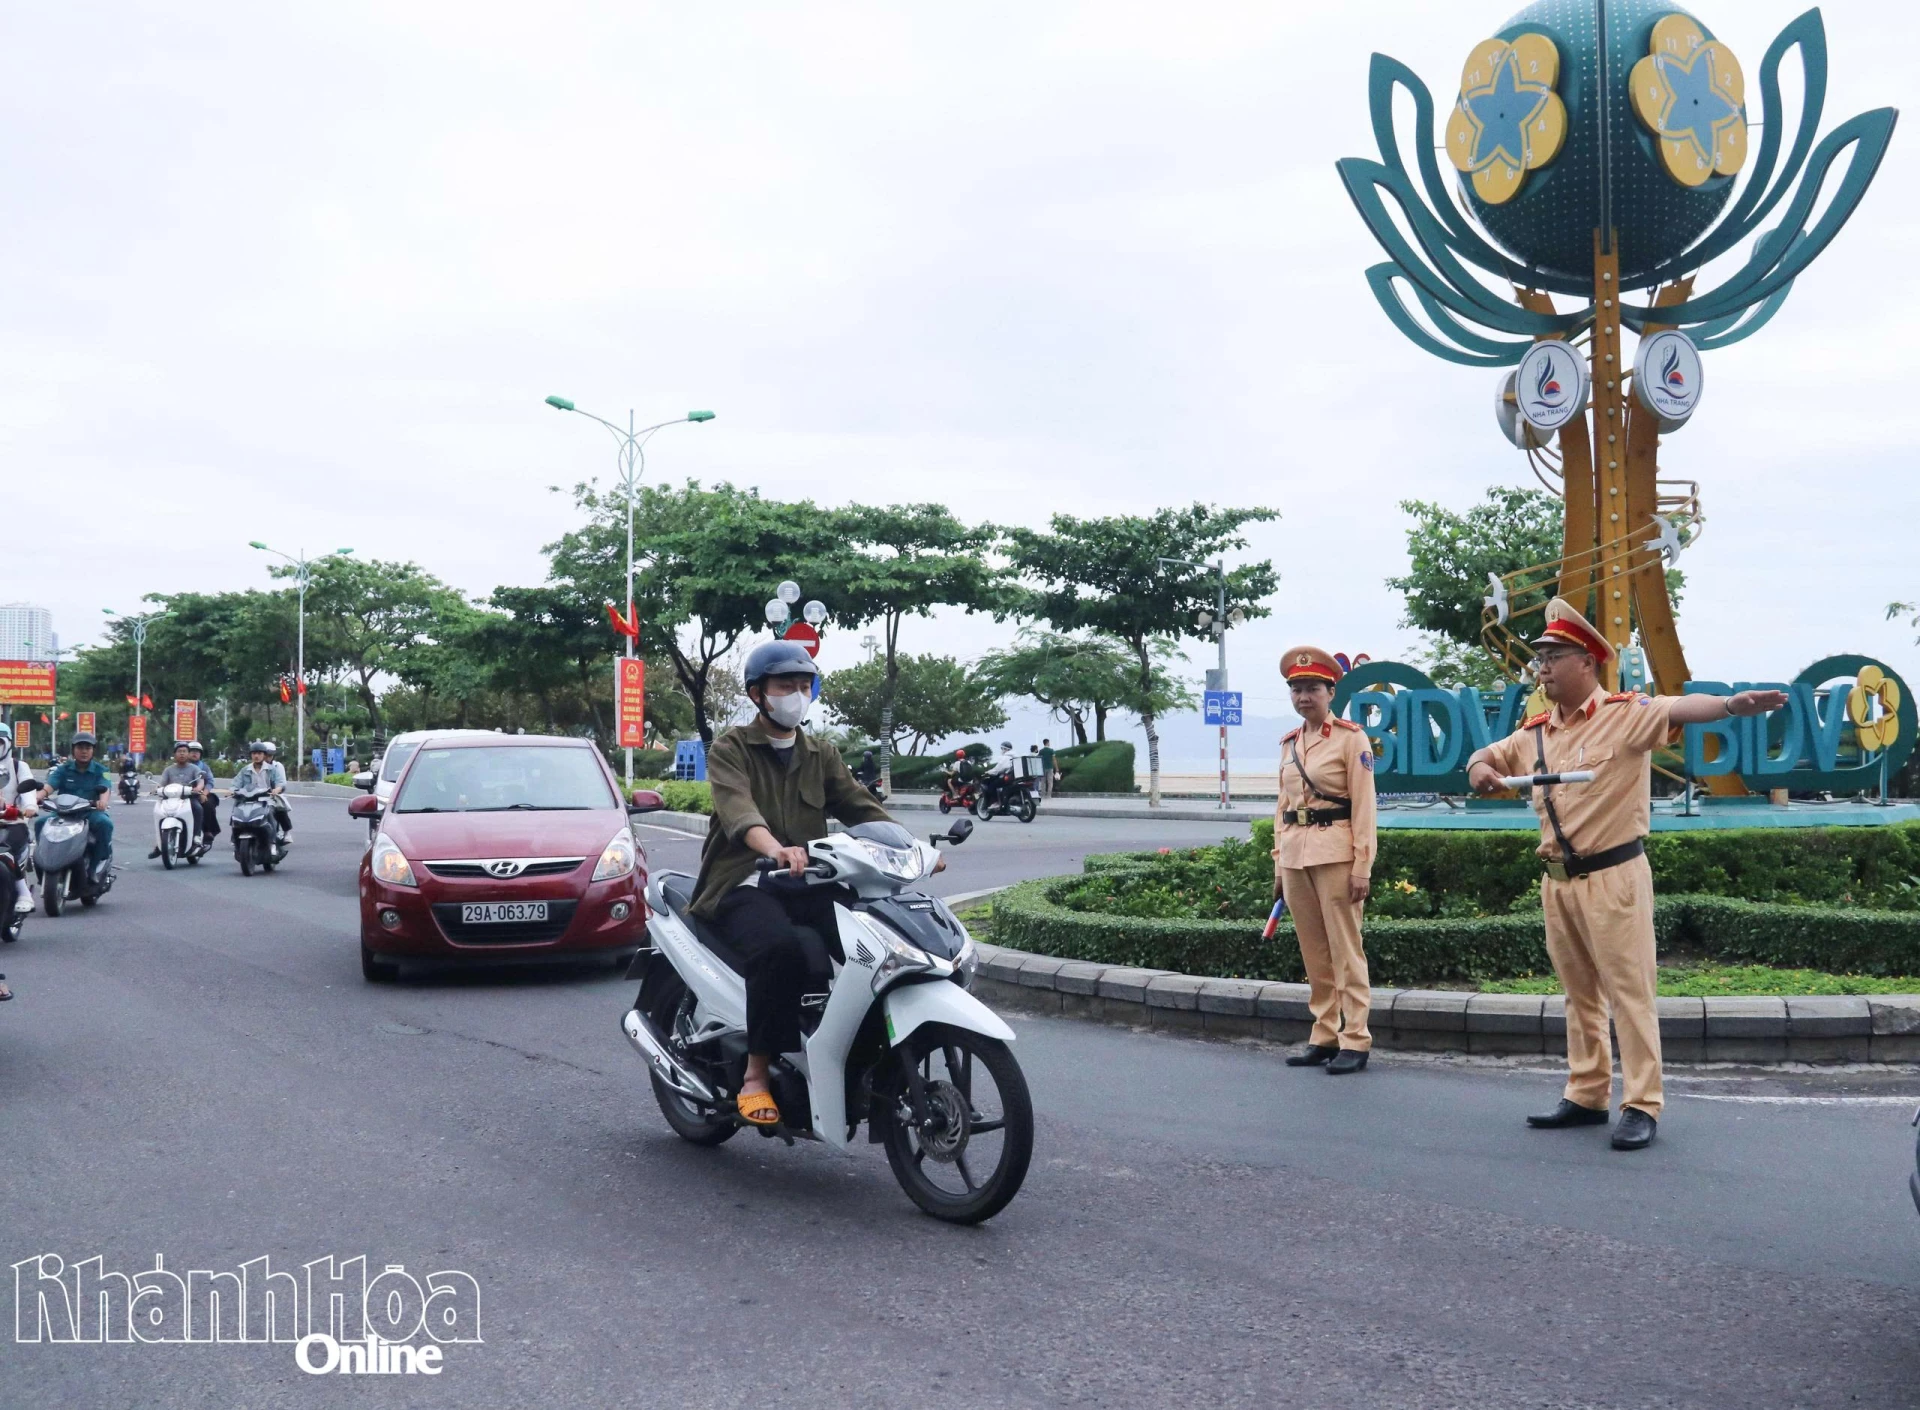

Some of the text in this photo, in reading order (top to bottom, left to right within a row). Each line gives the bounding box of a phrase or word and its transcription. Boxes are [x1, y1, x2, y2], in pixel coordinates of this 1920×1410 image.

[1666, 37, 1678, 51] 11
[1686, 35, 1698, 49] 12
[1487, 51, 1500, 66] 12
[1651, 55, 1664, 70] 10
[1530, 60, 1539, 74] 2
[1468, 70, 1481, 85] 11
[1724, 73, 1732, 87] 2
[1650, 87, 1657, 99] 9
[1458, 131, 1466, 145] 9
[1728, 133, 1736, 146] 4
[1673, 142, 1681, 156] 7
[1696, 156, 1704, 170] 6
[1483, 168, 1491, 182] 7
[1506, 167, 1514, 180] 6
[1656, 397, 1691, 408] NHA TRANG
[1532, 407, 1569, 419] NHA TRANG
[1350, 683, 1528, 776] BIDV
[1684, 681, 1853, 775] BIDV
[465, 904, 546, 921] 29A-063.79
[848, 956, 873, 970] HONDA
